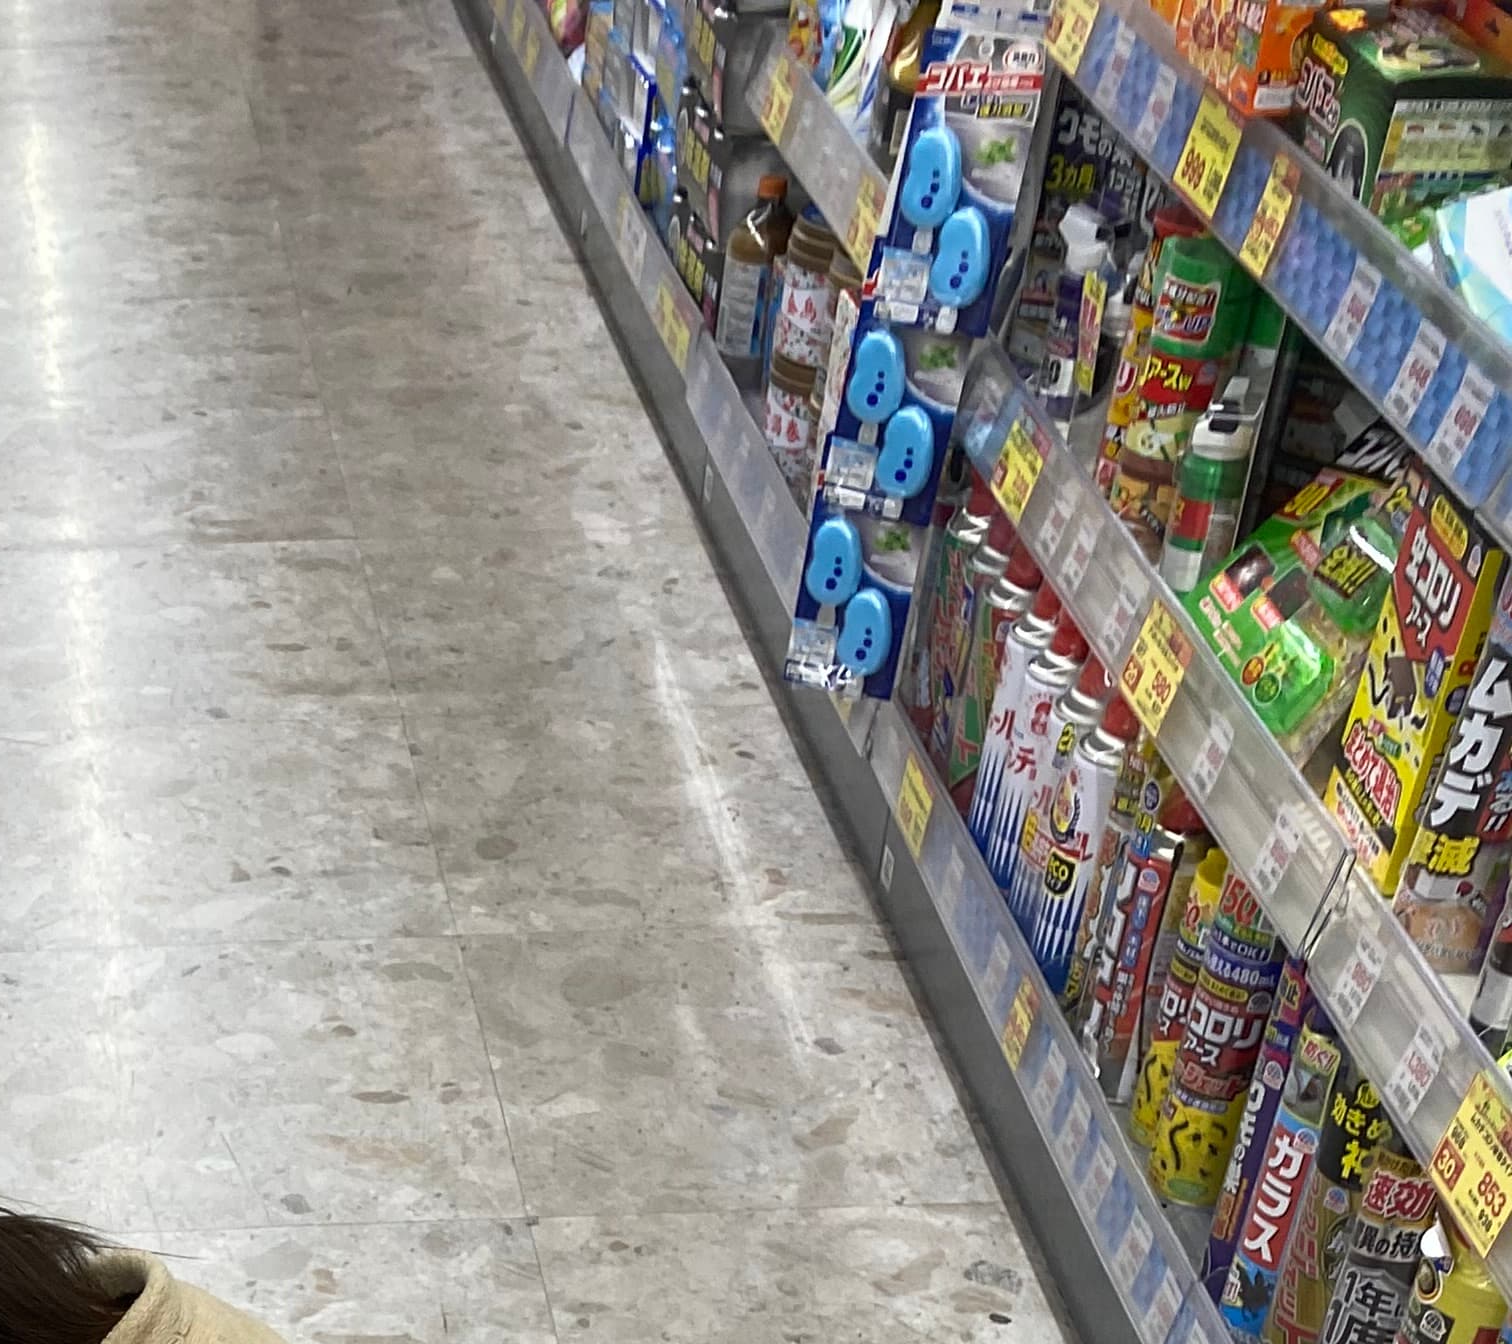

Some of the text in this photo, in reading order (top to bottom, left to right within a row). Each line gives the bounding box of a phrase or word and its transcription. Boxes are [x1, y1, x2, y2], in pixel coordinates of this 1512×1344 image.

[926, 61, 991, 92] コバエ
[1244, 1133, 1304, 1264] カラス
[1477, 1170, 1507, 1219] 853
